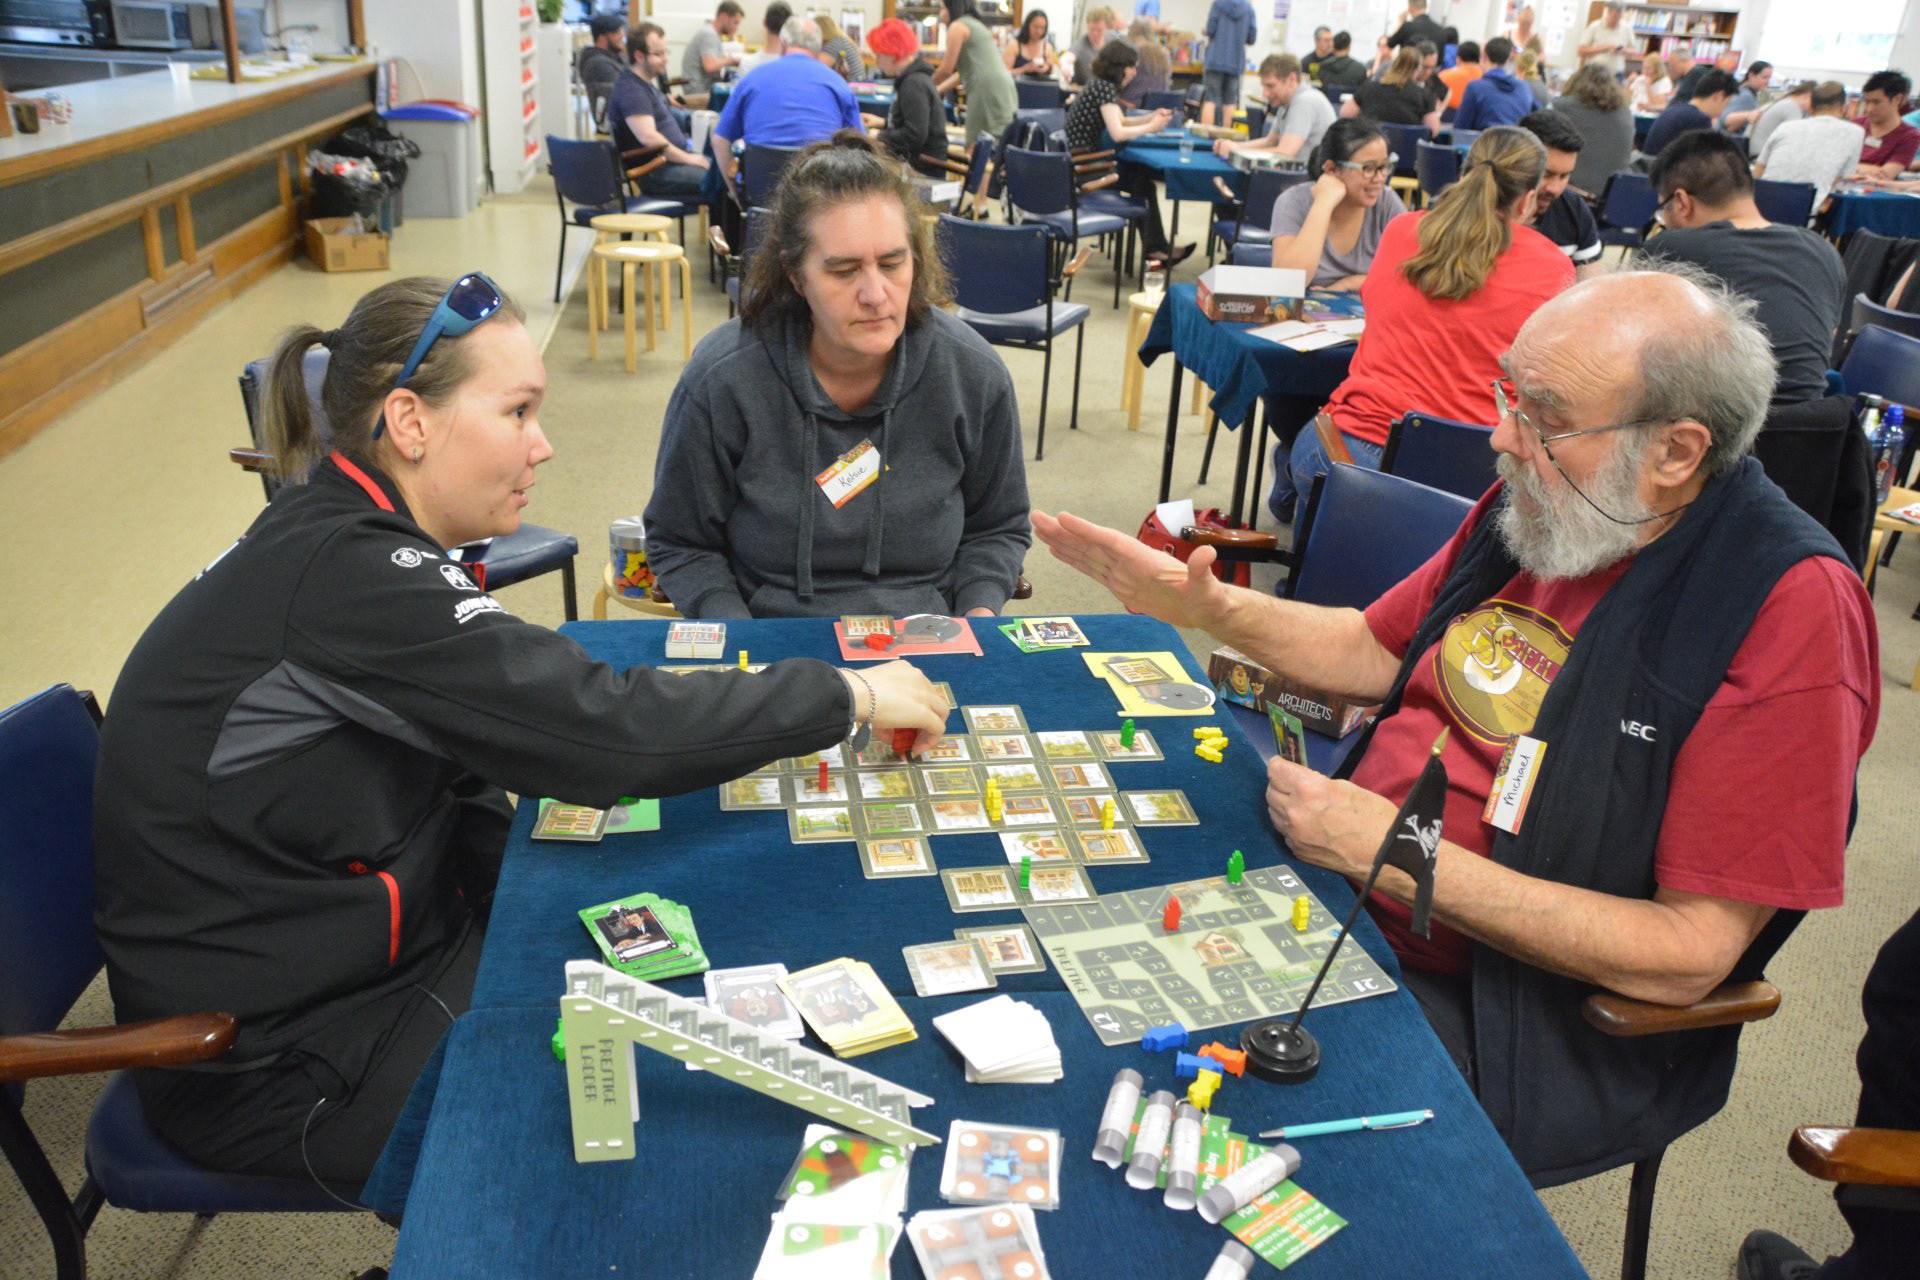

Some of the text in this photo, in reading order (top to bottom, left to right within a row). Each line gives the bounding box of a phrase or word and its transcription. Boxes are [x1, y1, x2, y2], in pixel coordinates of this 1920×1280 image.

[1277, 692, 1334, 721] ARCHITECTS
[1503, 754, 1531, 807] Michael
[1052, 946, 1089, 995] PRESTIGE
[1353, 978, 1379, 992] 21
[1093, 1011, 1121, 1034] 42
[580, 1044, 598, 1103] LADDER
[598, 1038, 617, 1107] PRESTIGE
